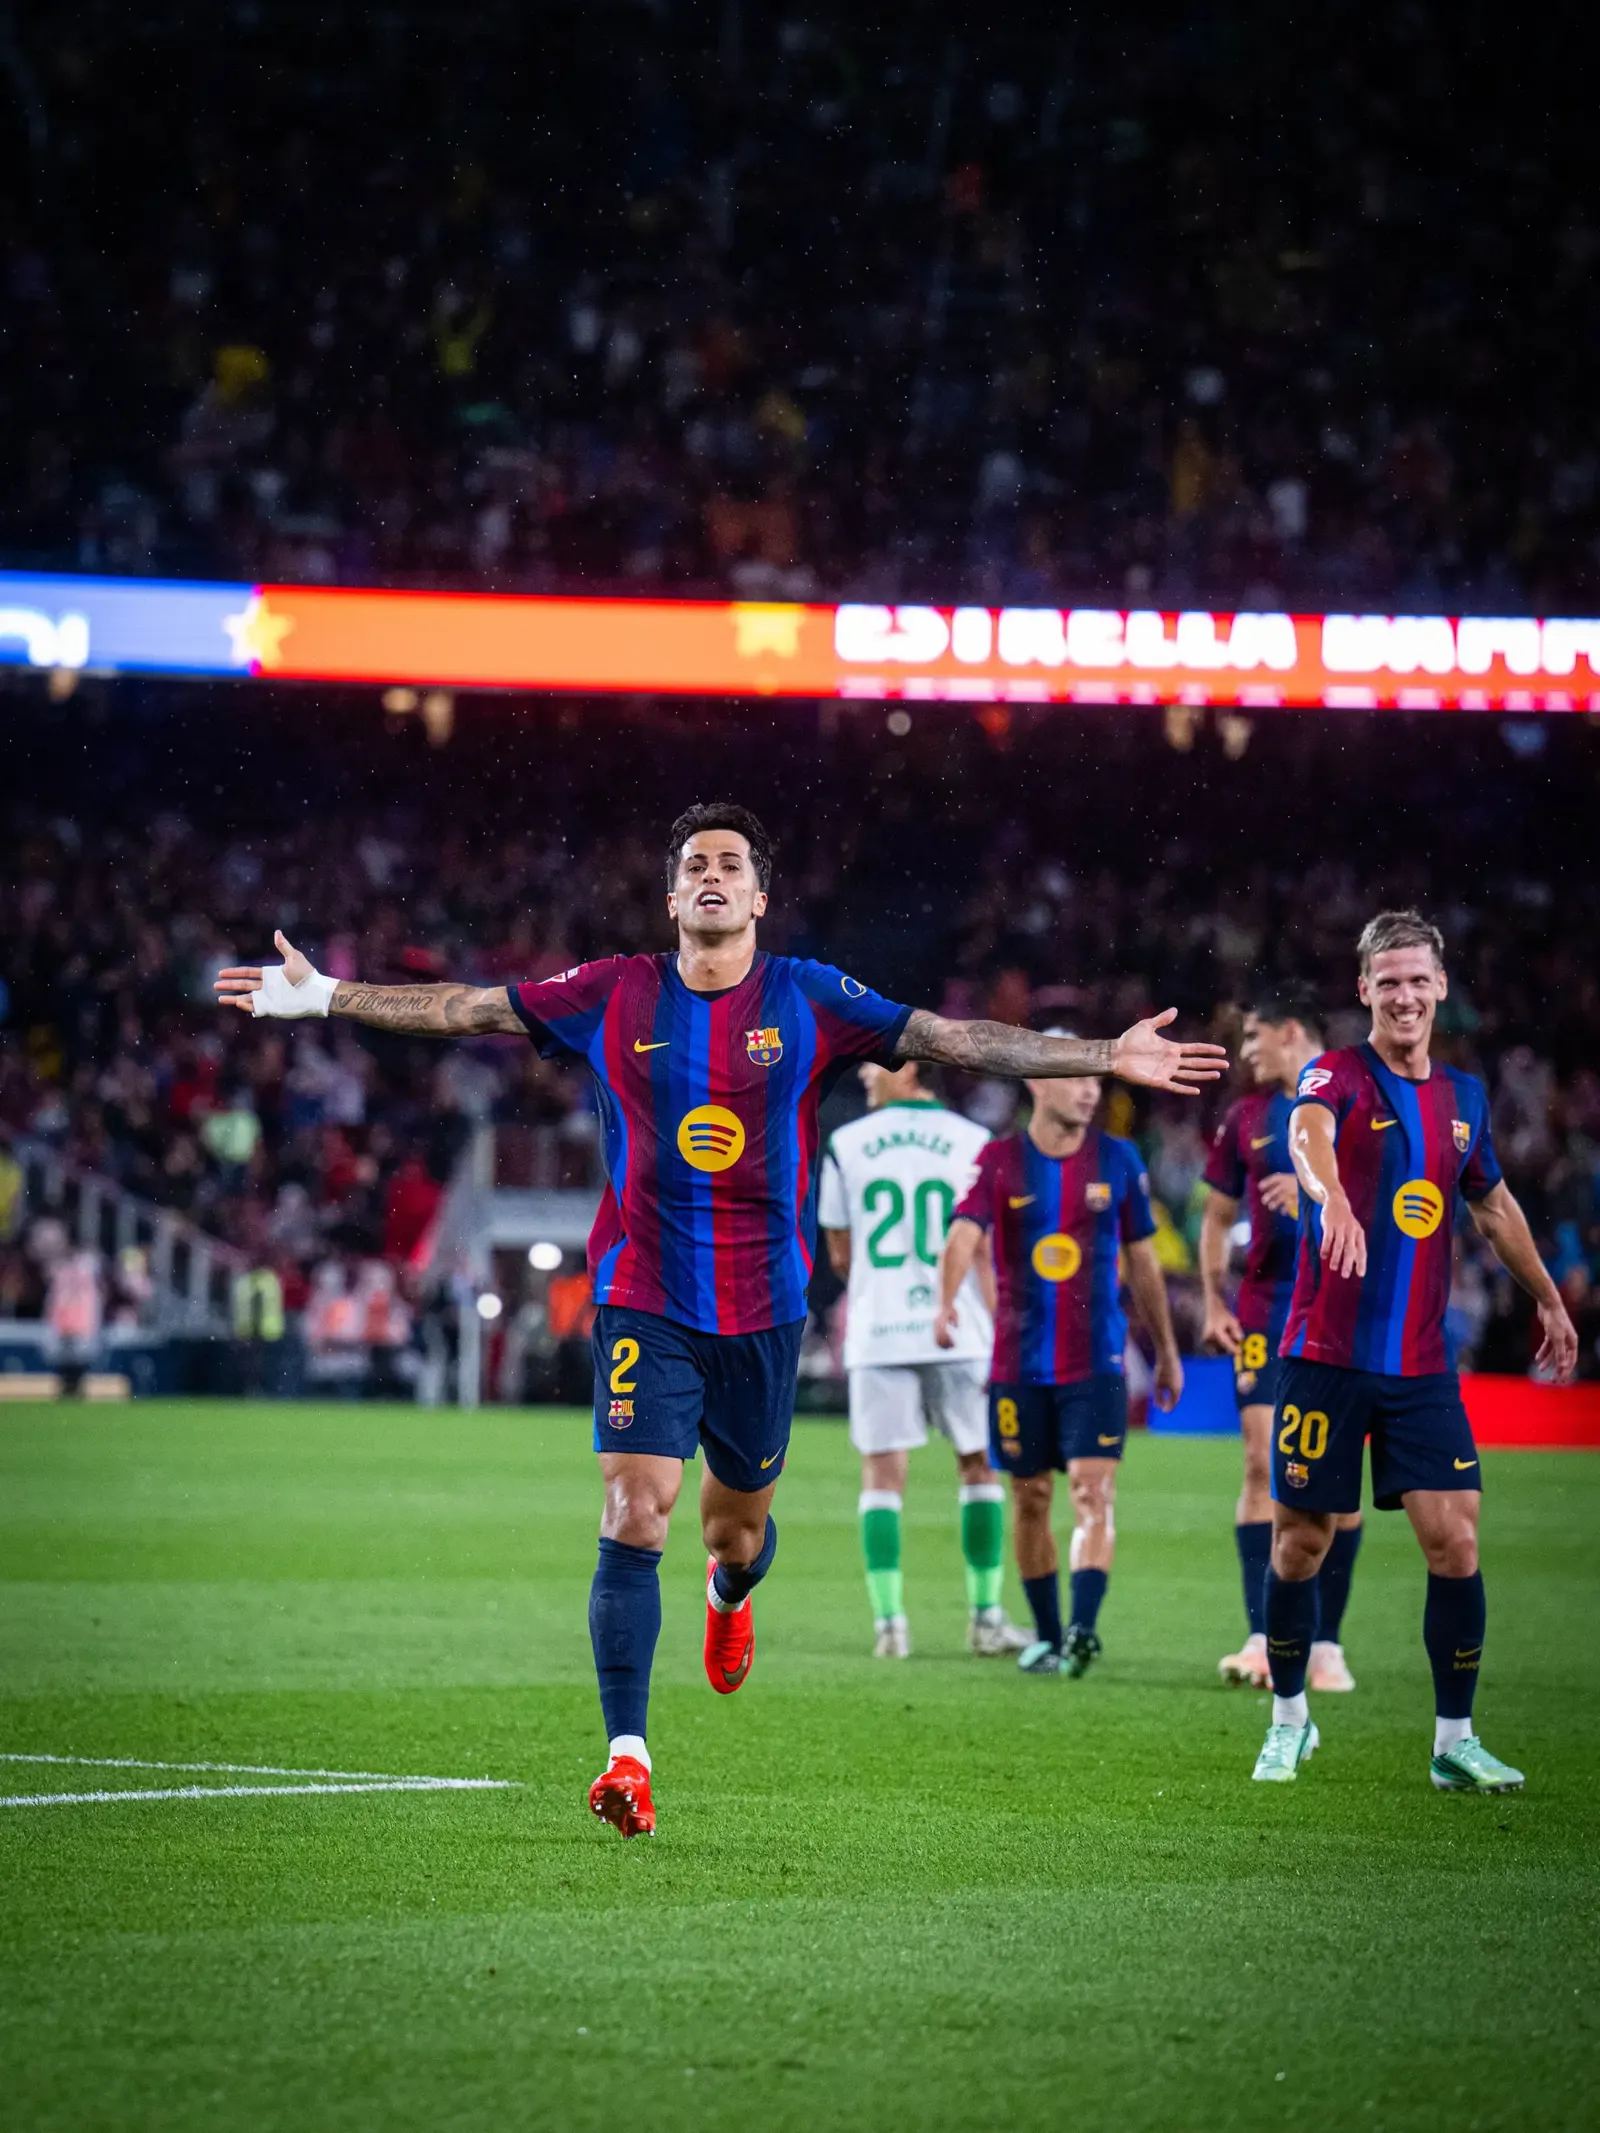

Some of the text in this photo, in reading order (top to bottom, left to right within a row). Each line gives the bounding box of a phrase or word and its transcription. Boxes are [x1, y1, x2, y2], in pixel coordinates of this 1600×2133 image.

[863, 1178, 956, 1268] 20
[610, 1338, 640, 1394] 2
[997, 1397, 1020, 1437] 8
[1278, 1404, 1329, 1459] 20
